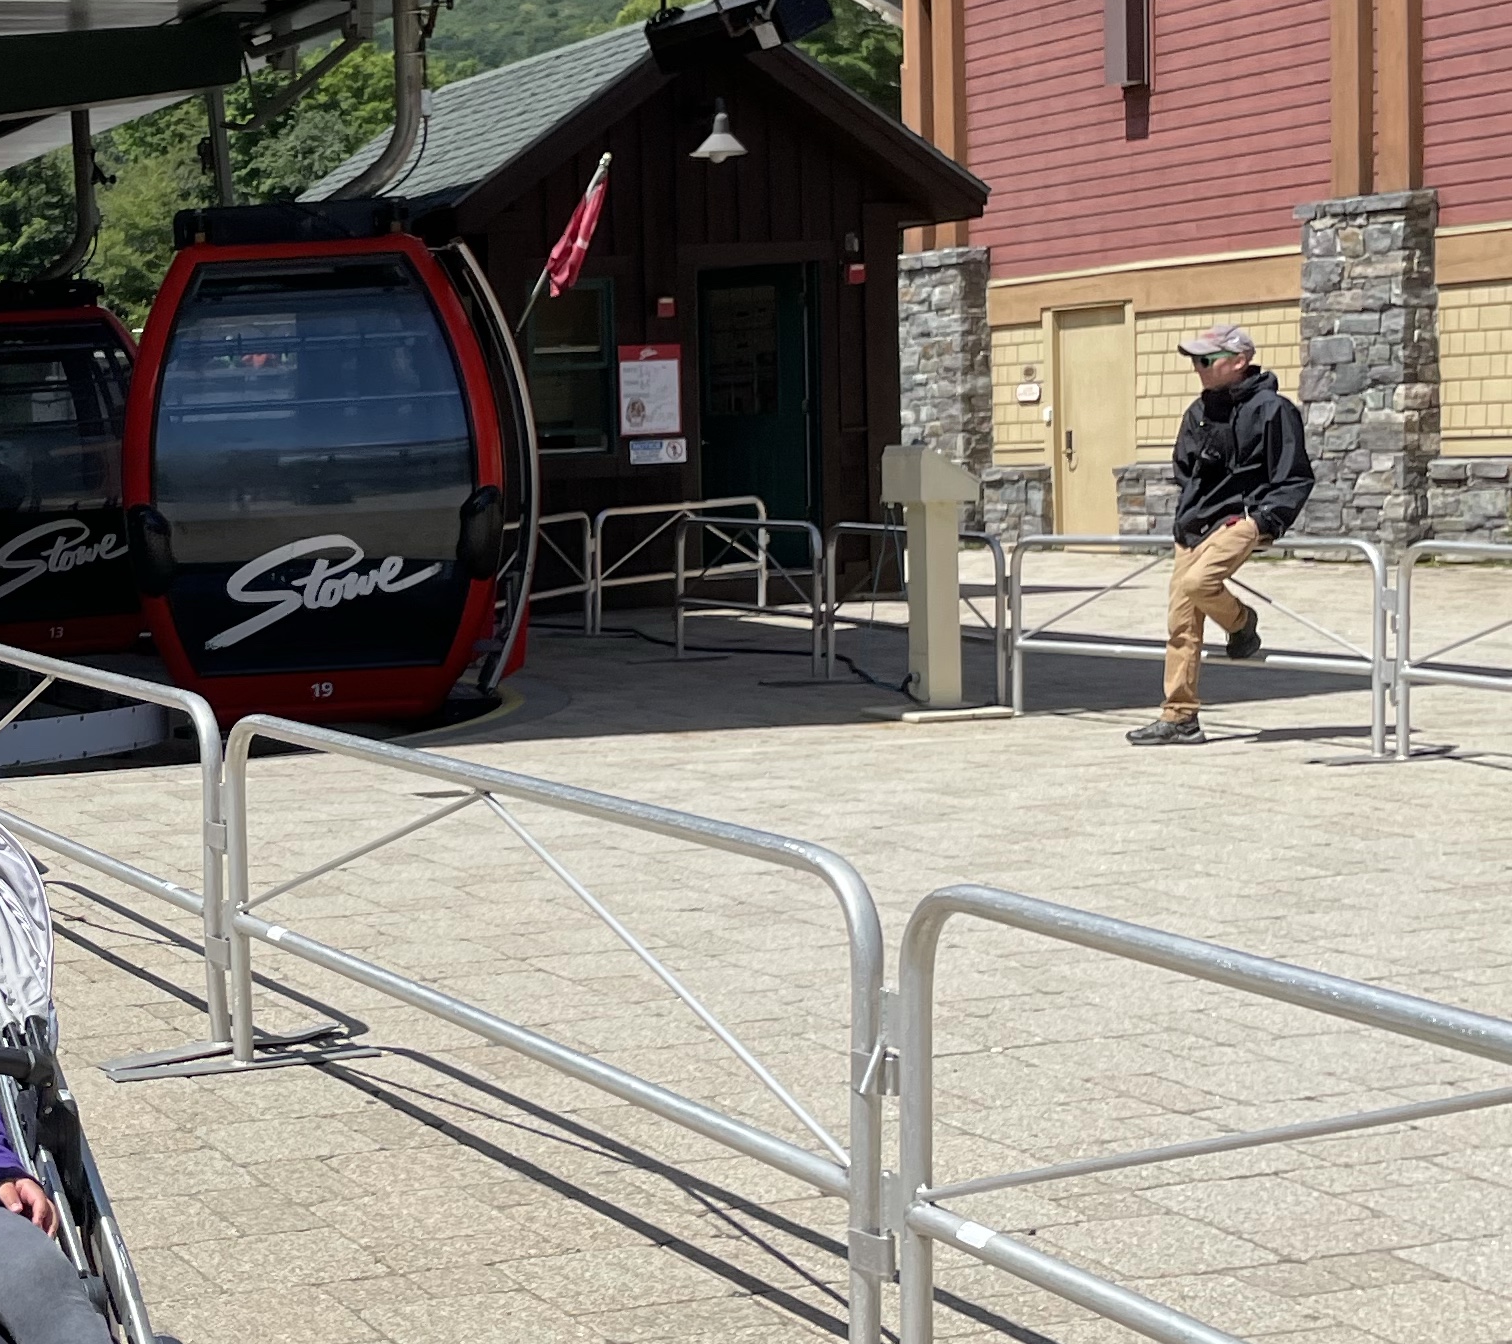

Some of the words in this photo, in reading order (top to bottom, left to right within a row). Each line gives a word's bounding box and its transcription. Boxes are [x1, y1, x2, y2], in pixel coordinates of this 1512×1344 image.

[205, 534, 443, 650] Stowe
[48, 626, 64, 639] 13
[310, 682, 334, 698] 19
